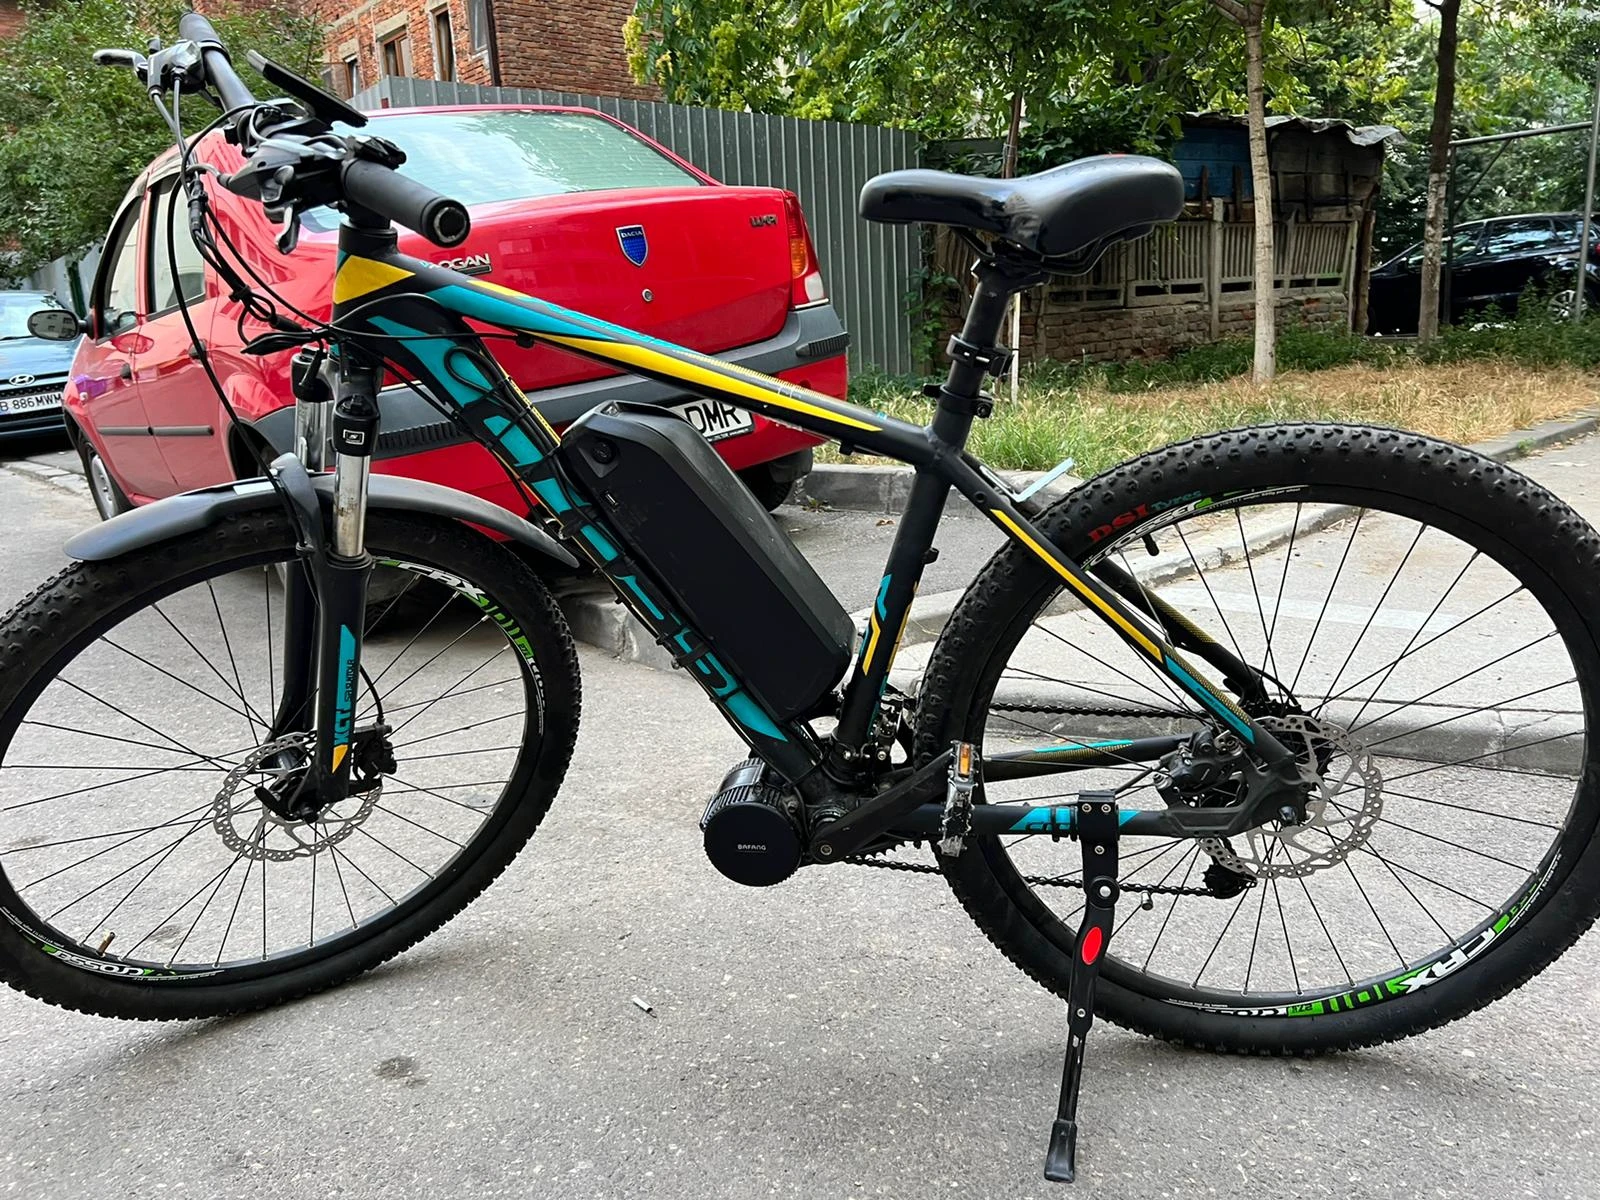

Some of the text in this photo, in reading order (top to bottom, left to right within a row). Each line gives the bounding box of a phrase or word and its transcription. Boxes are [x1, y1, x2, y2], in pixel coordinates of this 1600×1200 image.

[620, 230, 643, 238] DACIA
[437, 253, 491, 270] OGAN
[12, 397, 35, 410] 886
[1088, 503, 1150, 543] DSI
[1151, 490, 1204, 511] Tyres
[333, 709, 350, 746] XCT
[1399, 927, 1496, 994] CRX
